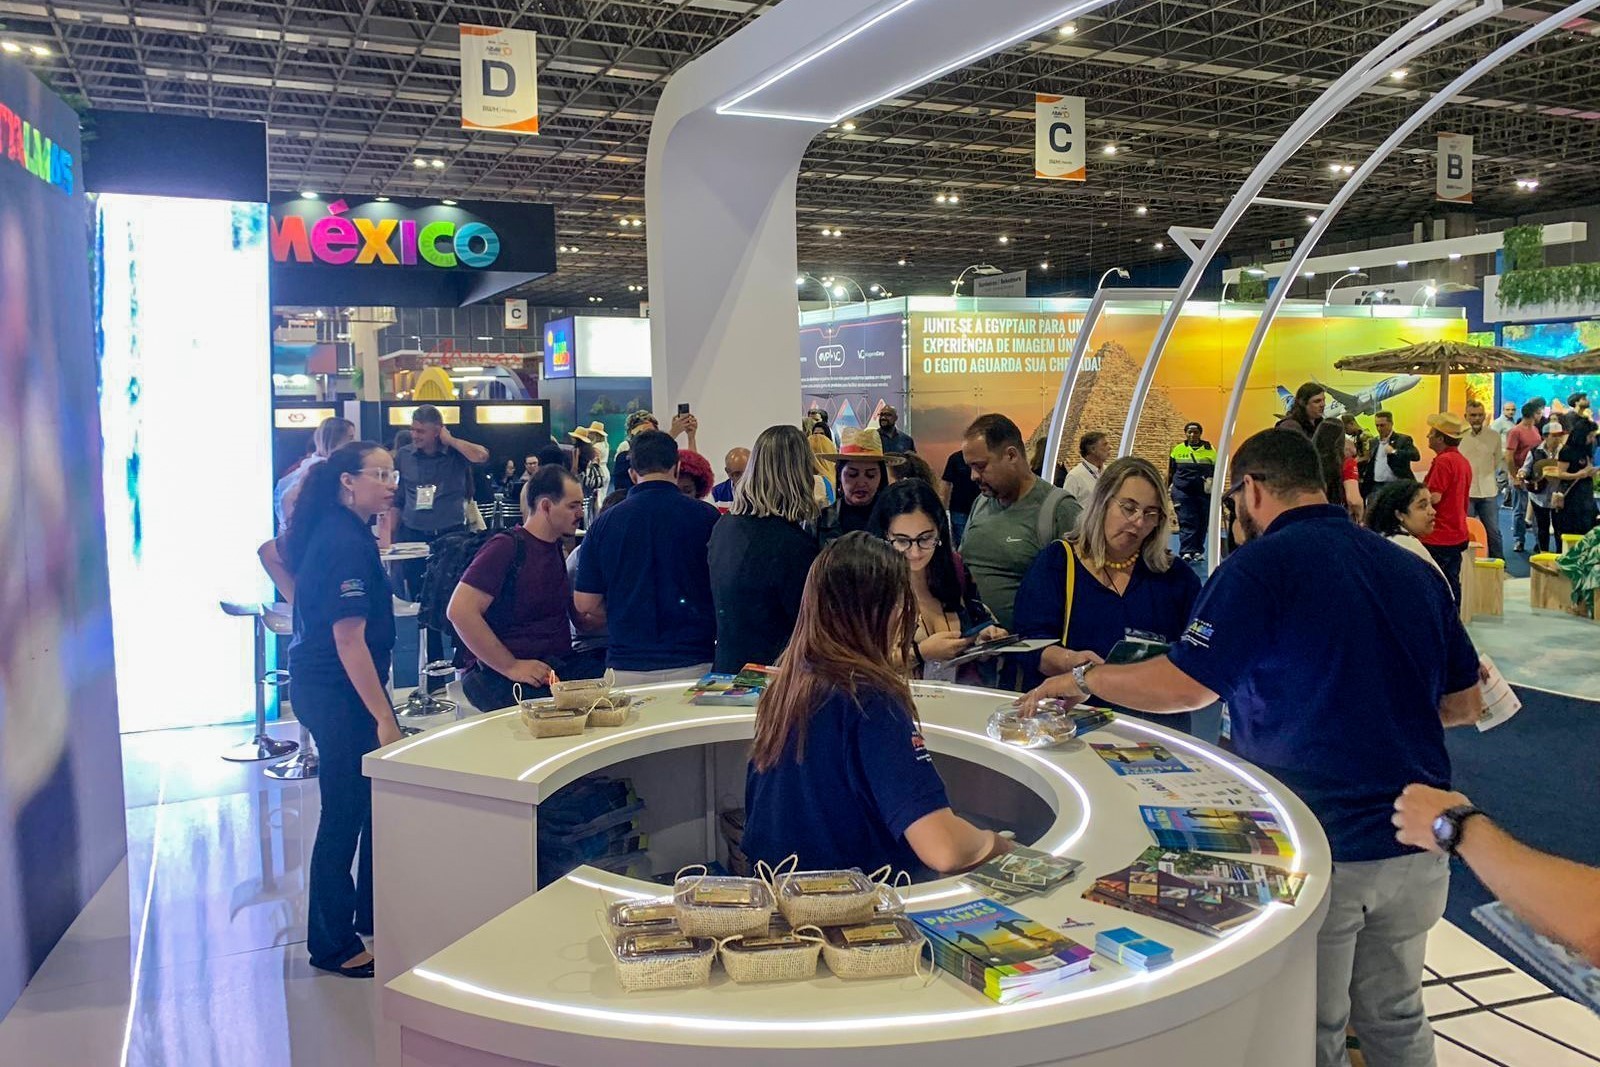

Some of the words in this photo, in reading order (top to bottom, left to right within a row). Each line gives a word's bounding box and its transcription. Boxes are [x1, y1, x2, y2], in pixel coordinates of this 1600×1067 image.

[482, 59, 516, 97] D
[1049, 122, 1072, 152] C
[1448, 154, 1463, 179] B
[511, 308, 522, 320] C
[923, 317, 973, 333] JUNTE-SE
[975, 318, 983, 333] A
[985, 318, 1036, 334] EGYPTAIR
[1039, 318, 1066, 334] PARA
[1068, 319, 1085, 334] UM
[923, 333, 994, 353] EXPERIÊNCIA
[996, 338, 1010, 353] DE
[1012, 338, 1055, 353] IMAGEM
[923, 358, 932, 374] O
[934, 358, 968, 374] EGITO
[969, 357, 1023, 373] AGUARDA
[1024, 357, 1047, 372] SUA
[922, 905, 998, 926] PALMAS
